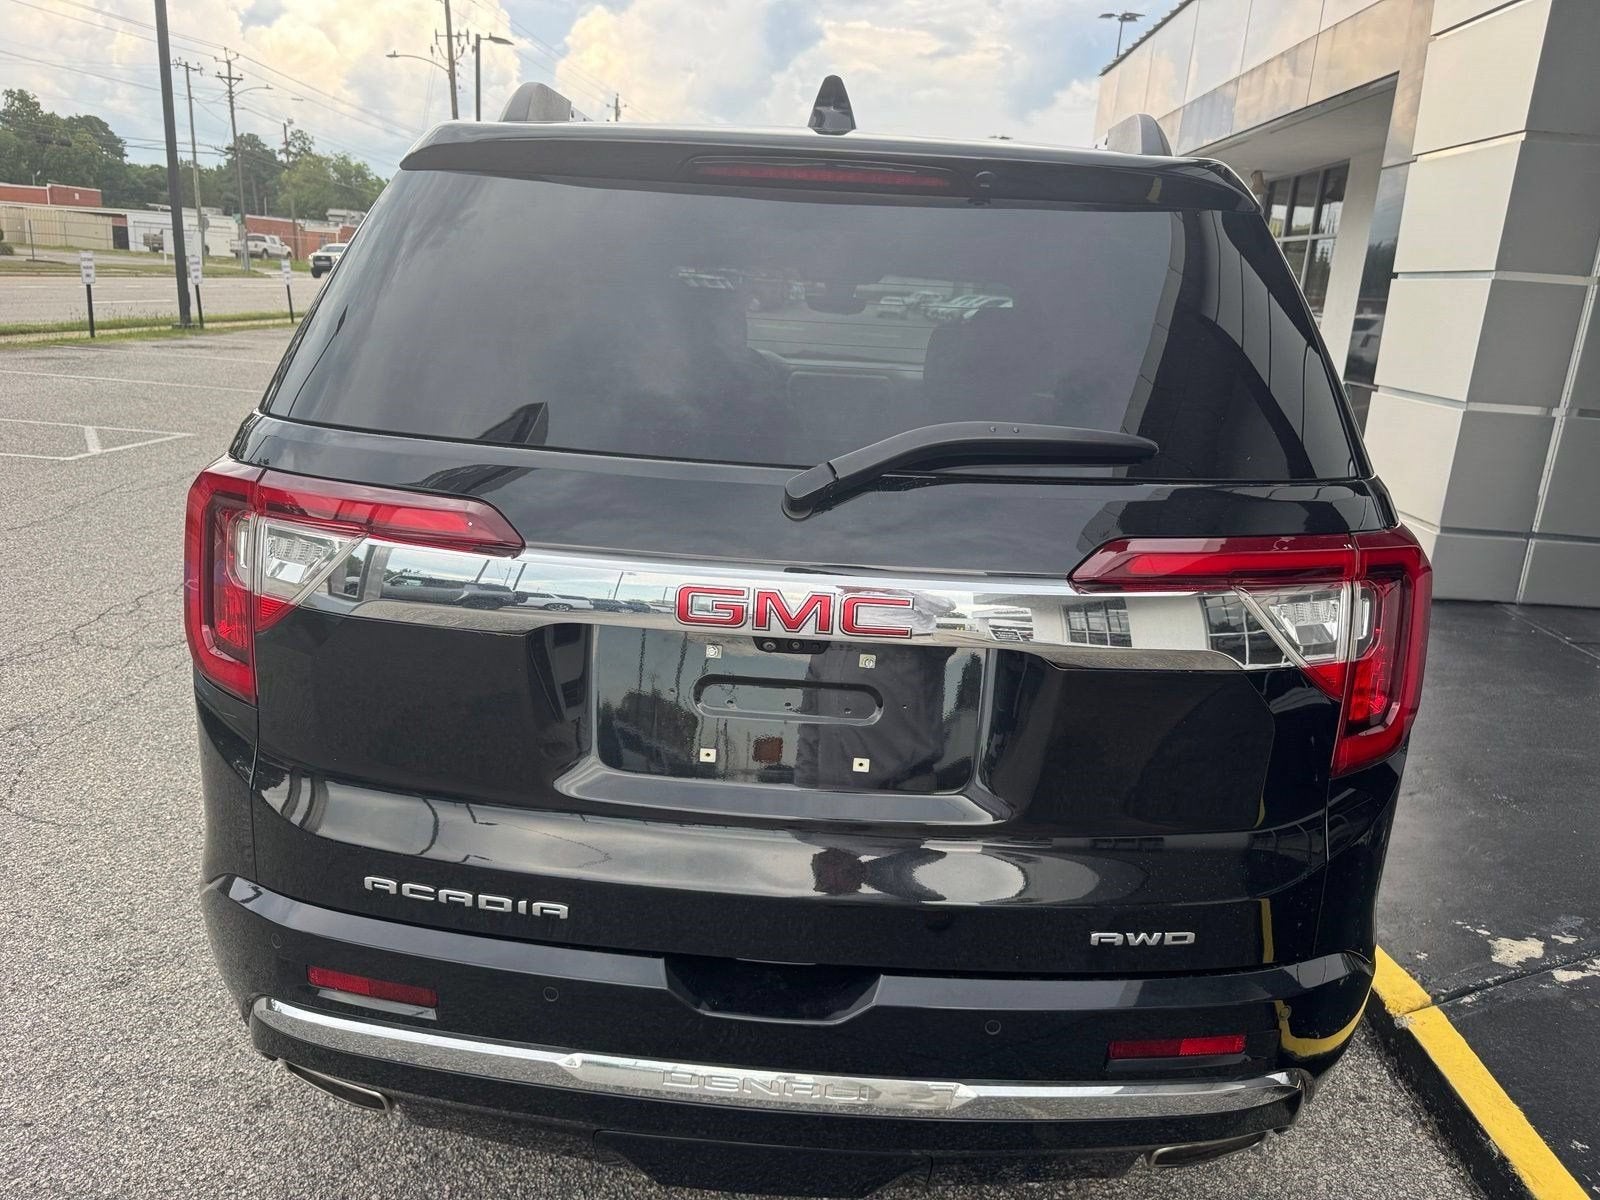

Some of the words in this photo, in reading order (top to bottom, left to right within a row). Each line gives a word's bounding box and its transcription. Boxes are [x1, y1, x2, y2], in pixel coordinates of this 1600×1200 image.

[675, 583, 914, 639] GMC
[363, 875, 569, 920] ACADIA
[1090, 931, 1196, 946] AWD
[662, 1069, 869, 1101] DENALI
